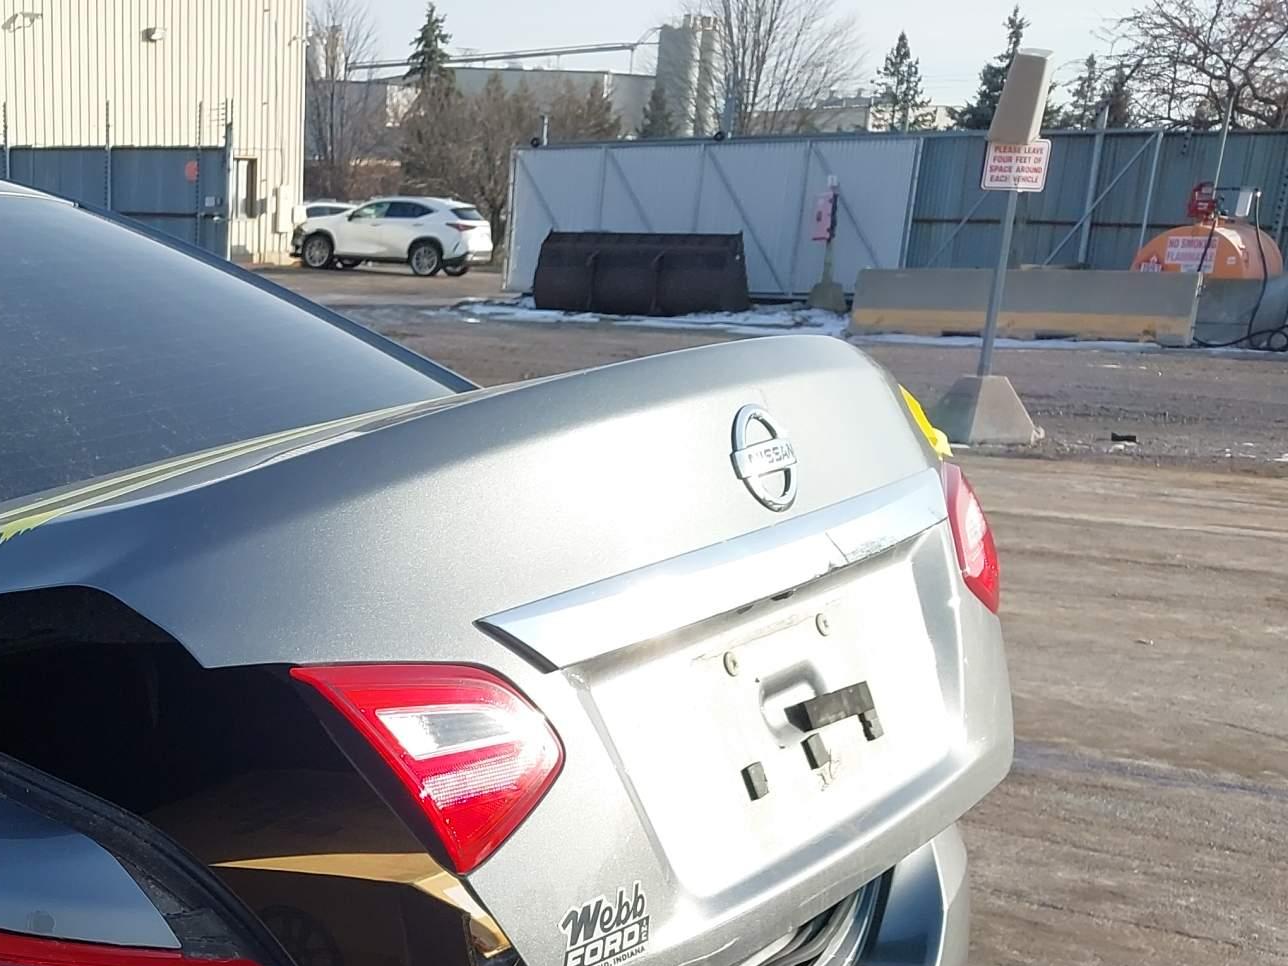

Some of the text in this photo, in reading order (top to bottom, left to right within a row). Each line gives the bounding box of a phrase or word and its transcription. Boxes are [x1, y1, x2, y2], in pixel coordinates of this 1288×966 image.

[994, 145, 1021, 154] PLEASE
[993, 155, 1013, 163] FOUR
[1033, 156, 1042, 164] OF
[989, 165, 1012, 173] SPACE
[1168, 239, 1180, 248] NO
[746, 442, 795, 465] NISSAN
[561, 882, 645, 947] Webb
[613, 945, 646, 966] INDIANA
